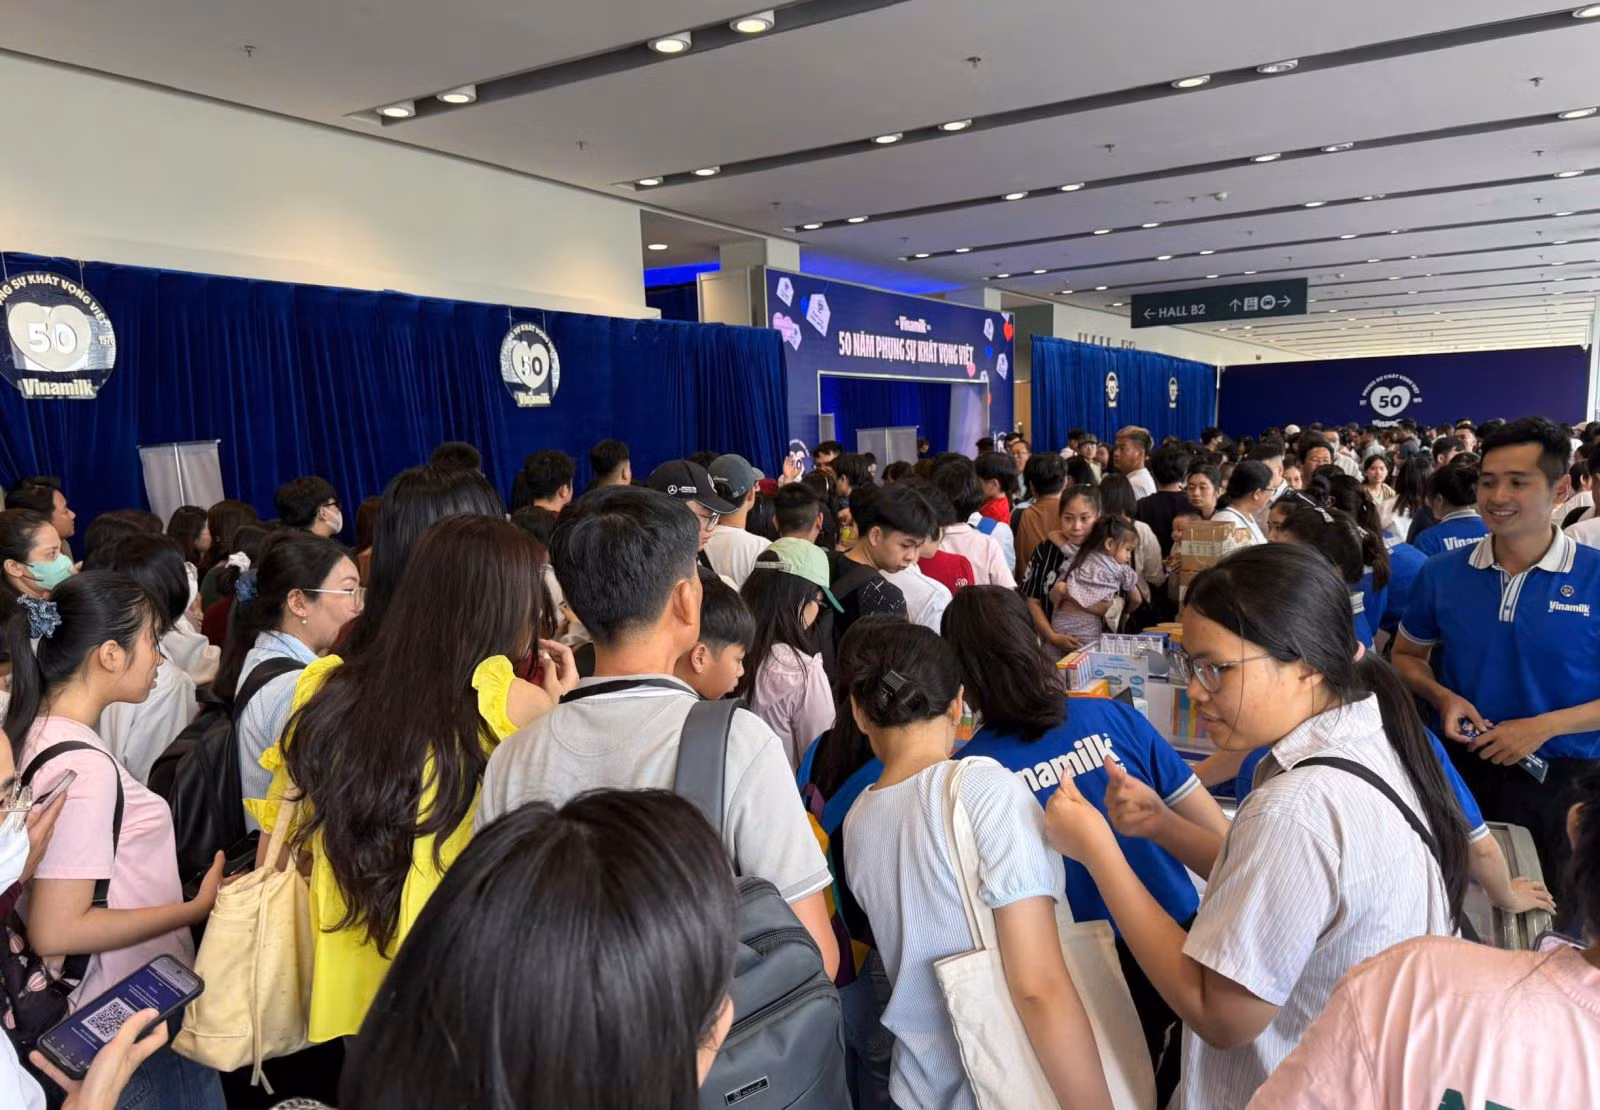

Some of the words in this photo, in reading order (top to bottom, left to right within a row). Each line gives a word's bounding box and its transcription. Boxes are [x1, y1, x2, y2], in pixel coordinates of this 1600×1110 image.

[27, 273, 60, 286] KHÁT
[61, 279, 91, 304] VỌNG
[1158, 305, 1189, 319] HALL
[1190, 303, 1207, 316] B2
[26, 322, 78, 355] 50
[838, 330, 852, 356] 50
[853, 330, 875, 358] NĂM
[876, 335, 905, 362] PHỤNG
[905, 338, 917, 364] SỤ
[918, 339, 938, 364] KHÁT
[938, 343, 958, 367] VỌNG
[22, 378, 95, 396] Vinamilk
[1379, 394, 1403, 409] 50
[1549, 599, 1591, 614] Vinamilk
[1014, 733, 1121, 792] namilk
